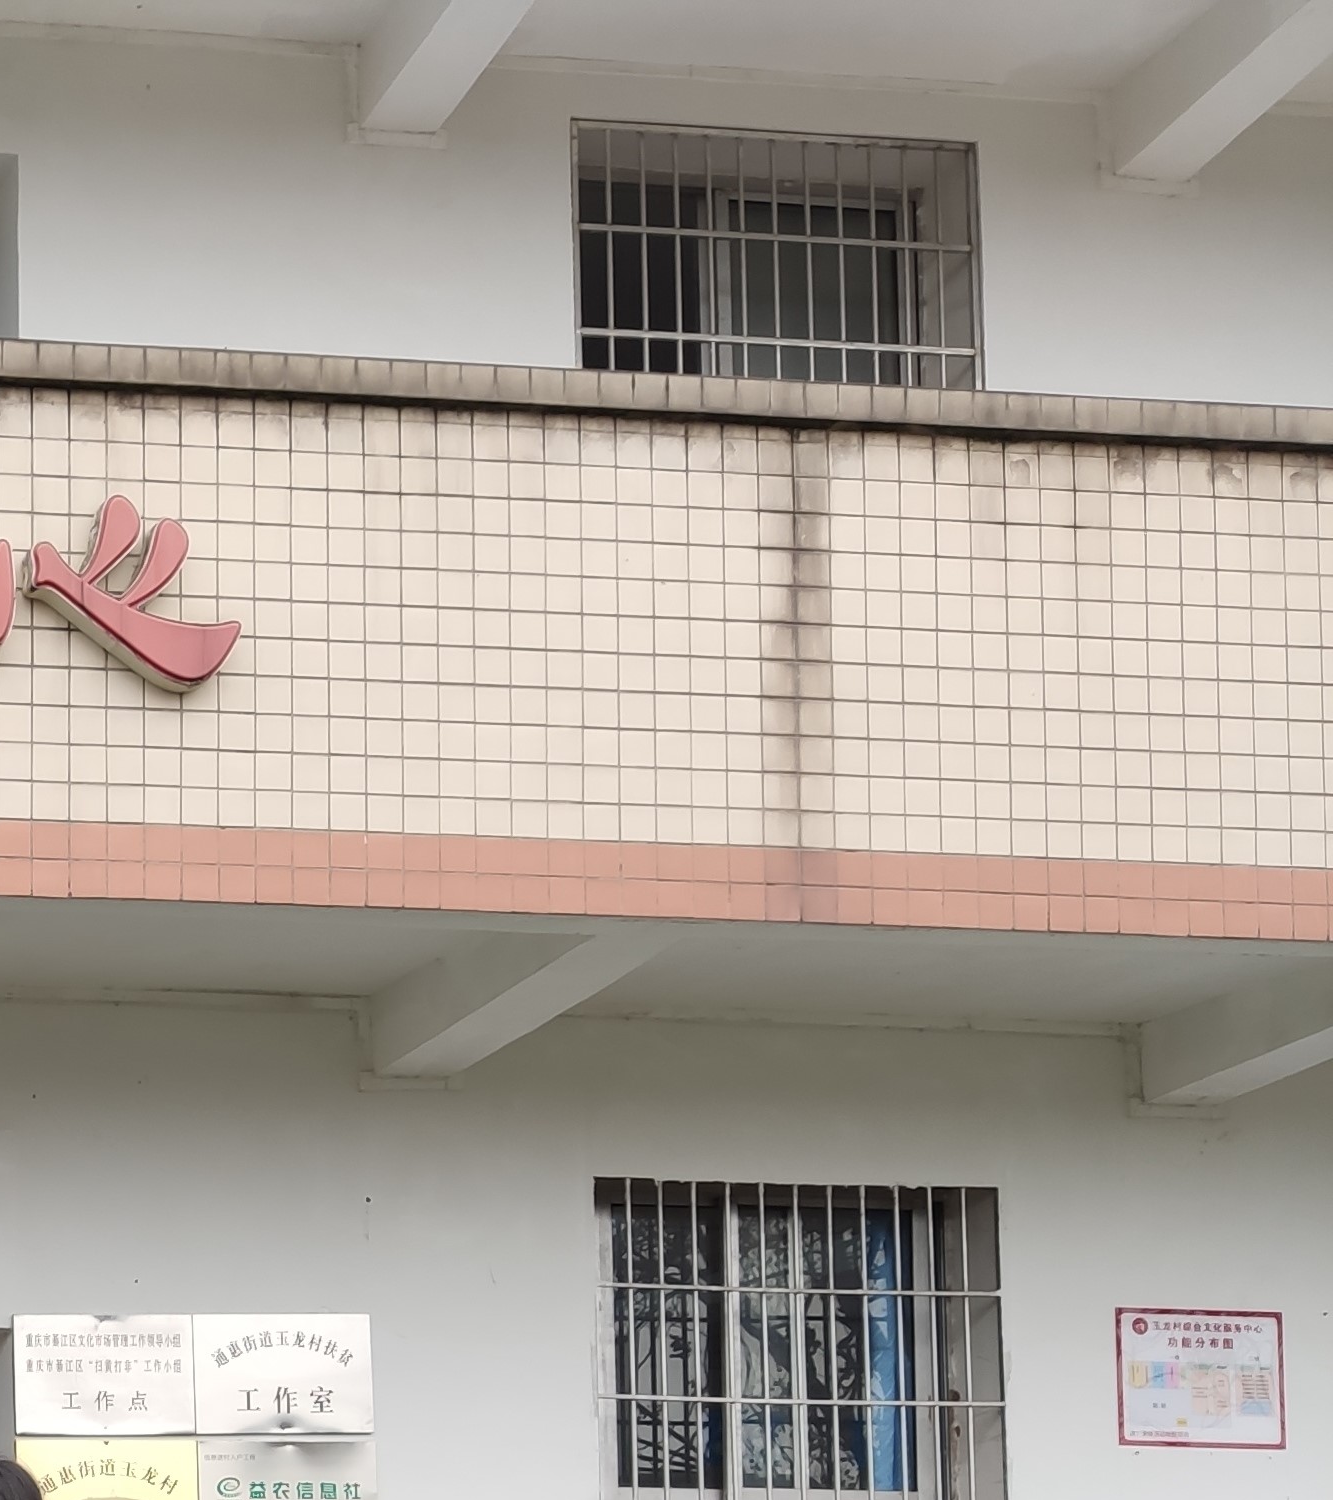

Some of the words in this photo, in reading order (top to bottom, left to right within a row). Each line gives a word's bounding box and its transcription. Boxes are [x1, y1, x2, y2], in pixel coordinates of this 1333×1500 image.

[210, 1330, 354, 1369] 通惠街道玉龙村扶贫
[62, 1390, 149, 1412] 工作点
[237, 1386, 335, 1414] 工作室
[38, 1458, 179, 1495] 通惠街道玉龙村
[248, 1481, 362, 1500] 益农信息社
